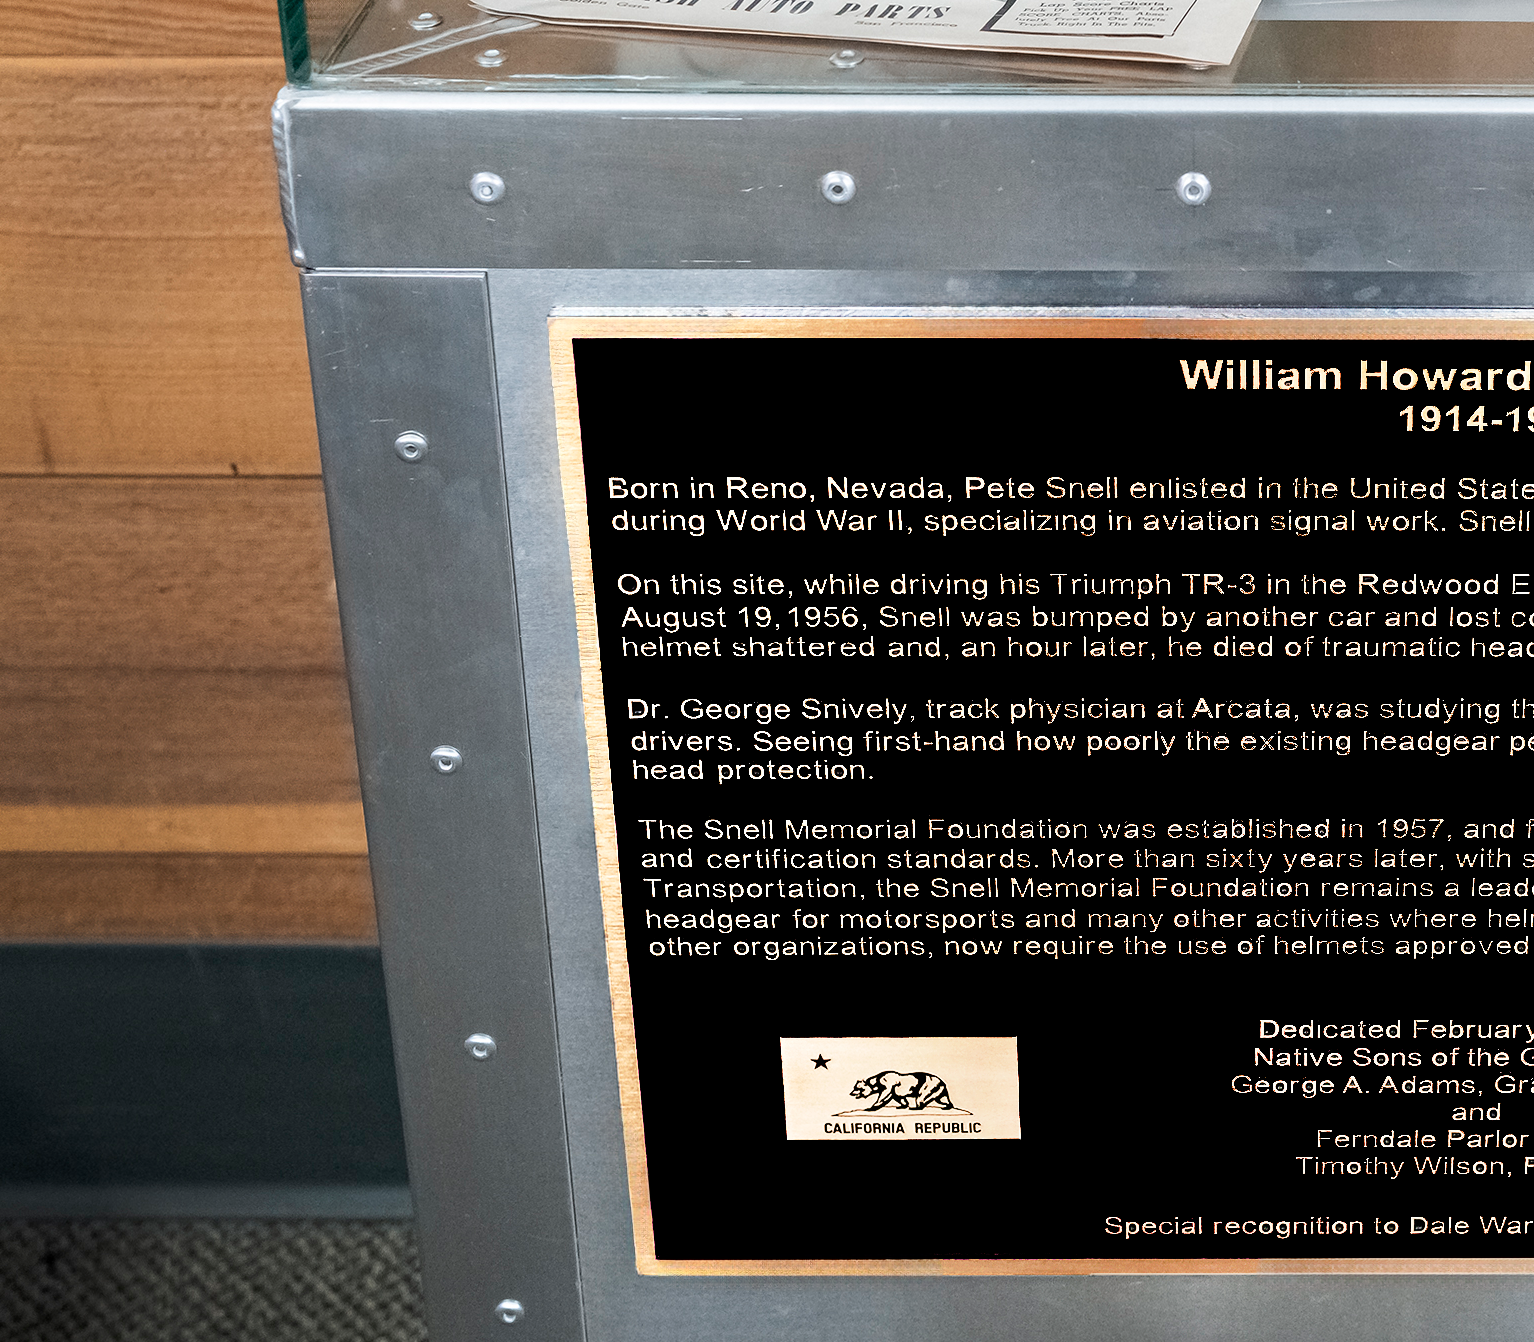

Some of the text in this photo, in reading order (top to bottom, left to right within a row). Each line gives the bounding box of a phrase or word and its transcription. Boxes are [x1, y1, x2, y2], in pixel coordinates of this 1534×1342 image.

[615, 0, 651, 10] Gate
[835, 3, 952, 19] PARTS
[1179, 359, 1342, 391] William
[1359, 359, 1532, 392] Howard
[608, 476, 679, 500] Born
[690, 476, 715, 499] in
[726, 476, 815, 503] Reno,
[827, 476, 953, 503] Nevada,
[965, 476, 1035, 499] Pete
[1046, 476, 1119, 499] Snell
[1129, 476, 1246, 499] enlisted
[1258, 476, 1282, 499] in
[1294, 476, 1339, 499] the
[1350, 477, 1446, 500] United
[649, 936, 722, 957] other
[733, 935, 933, 961] organizations,
[944, 940, 1003, 956] now
[1013, 935, 1114, 960] require
[1123, 935, 1167, 955] the
[1178, 940, 1227, 955] use
[1237, 934, 1266, 955] of
[1274, 935, 1385, 955] helmets
[1395, 935, 1529, 960] approved
[1259, 1019, 1401, 1039] Dedicated
[1254, 1047, 1343, 1067] Native
[1352, 1047, 1422, 1067] Sons
[1431, 1046, 1461, 1067] of
[1466, 1047, 1510, 1067] the
[1231, 1074, 1335, 1099] George
[1342, 1075, 1370, 1094] A.
[1378, 1075, 1483, 1097] Adams,
[1451, 1102, 1501, 1121] and
[823, 1121, 982, 1135] CALIFORNIA REPUBLIC
[1317, 1129, 1437, 1149] Ferndale
[1447, 1129, 1530, 1149] Parlor
[1295, 1156, 1405, 1180] Timothy
[1413, 1156, 1512, 1178] Wilson,
[1104, 1216, 1203, 1240] Special
[1213, 1216, 1364, 1240] recognition
[1375, 1217, 1400, 1235] to
[1409, 1216, 1470, 1235] Dale
